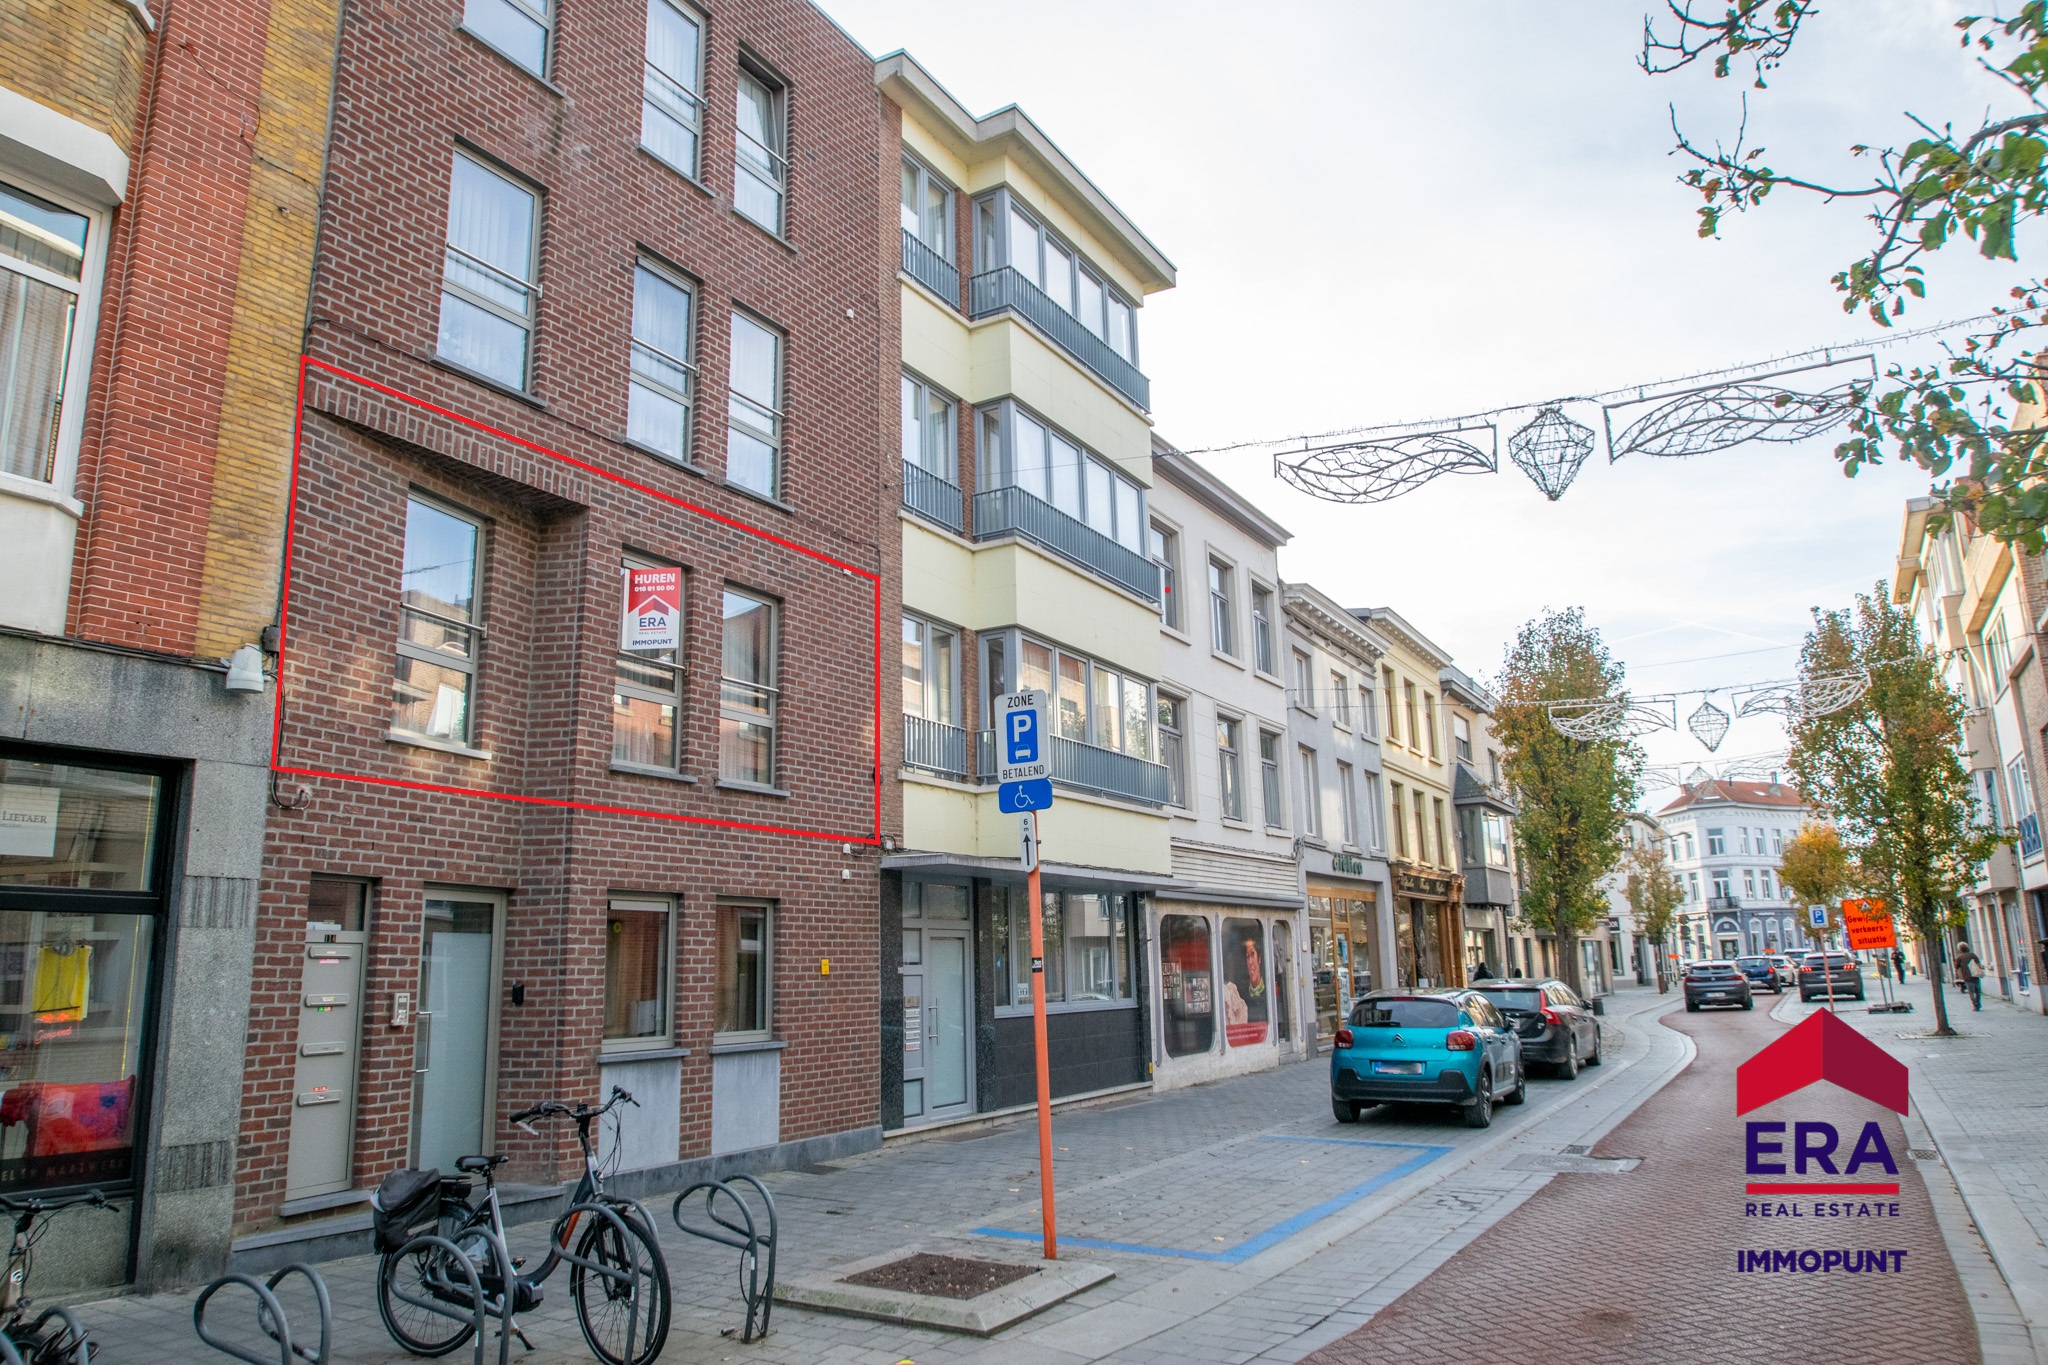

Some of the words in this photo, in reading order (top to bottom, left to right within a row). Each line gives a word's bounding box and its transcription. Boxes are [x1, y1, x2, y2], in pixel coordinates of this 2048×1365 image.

[635, 573, 675, 584] HUREN
[639, 617, 666, 627] ERA
[632, 638, 673, 646] IMMOPUNT
[1007, 694, 1034, 708] ZONE
[1013, 714, 1032, 743] P
[1002, 764, 1045, 780] BETALEND
[1023, 818, 1028, 826] 6
[1857, 936, 1887, 945] situatie
